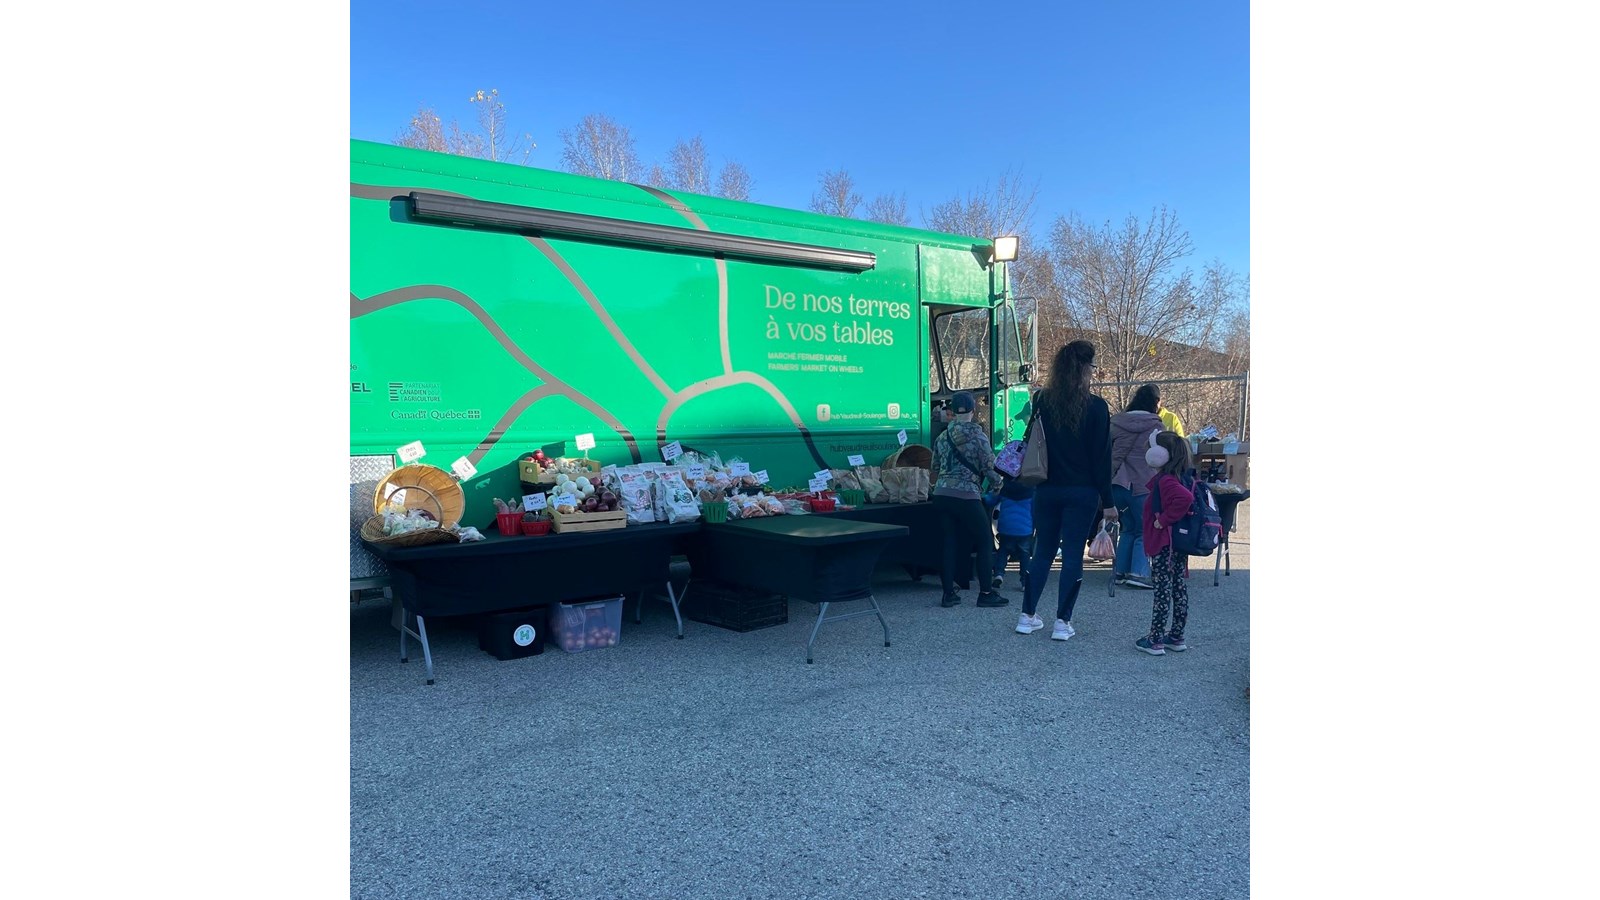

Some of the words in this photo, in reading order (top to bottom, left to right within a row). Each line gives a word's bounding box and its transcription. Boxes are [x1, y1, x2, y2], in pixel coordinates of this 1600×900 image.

[764, 284, 796, 310] De
[803, 293, 843, 314] nos
[849, 293, 911, 320] terres
[766, 314, 780, 340] à
[786, 322, 827, 342] vos
[832, 320, 894, 346] tables
[797, 352, 825, 361] FERMIER
[825, 354, 848, 362] MOBILE
[801, 364, 827, 372] MARKET
[839, 365, 864, 373] WHEELS
[391, 410, 427, 419] Canada
[430, 410, 467, 420] Québec
